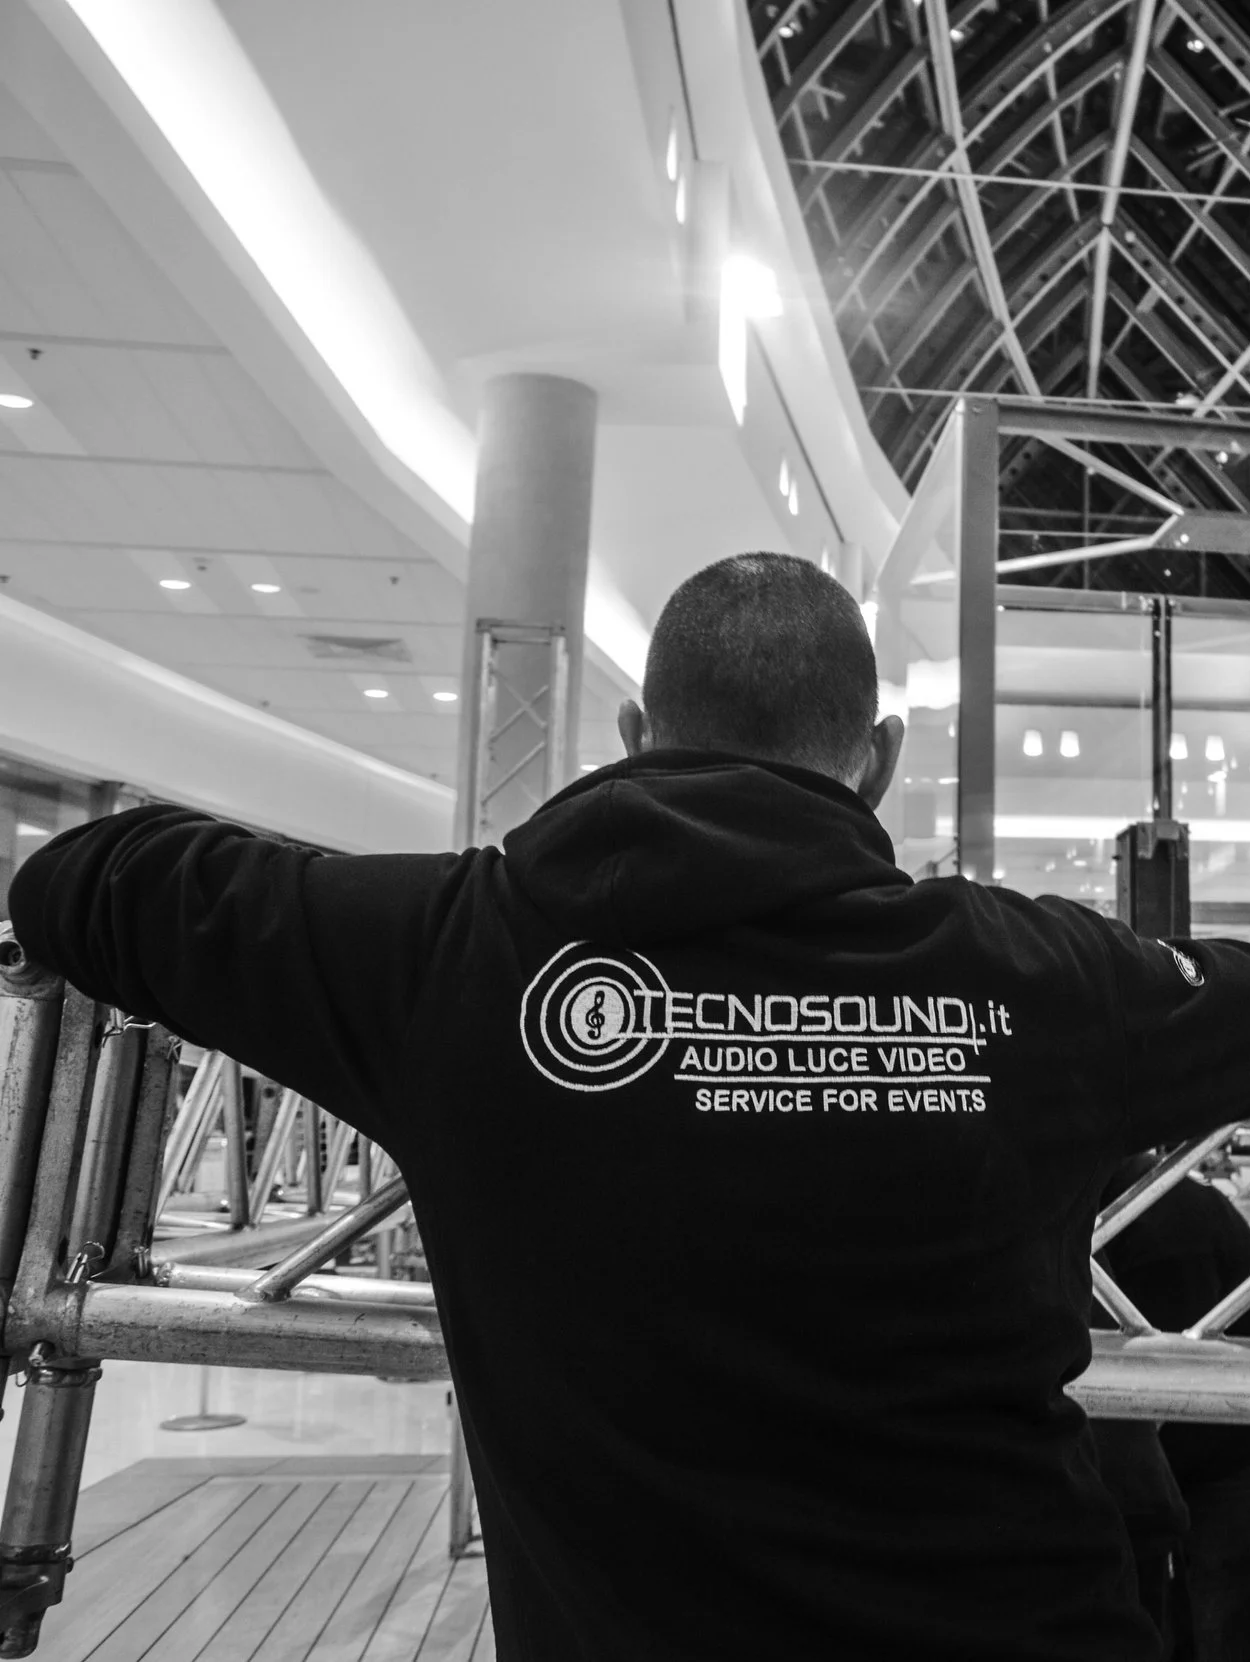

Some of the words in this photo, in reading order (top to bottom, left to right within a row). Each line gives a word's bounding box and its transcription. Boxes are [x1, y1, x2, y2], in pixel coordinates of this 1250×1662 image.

[680, 1046, 777, 1072] AUDIO
[788, 1047, 869, 1073] LUCE
[878, 1047, 965, 1072] VIDEO
[696, 1089, 812, 1112] SERVICE
[823, 1089, 878, 1111] FOR
[888, 1089, 986, 1112] EVENTS
